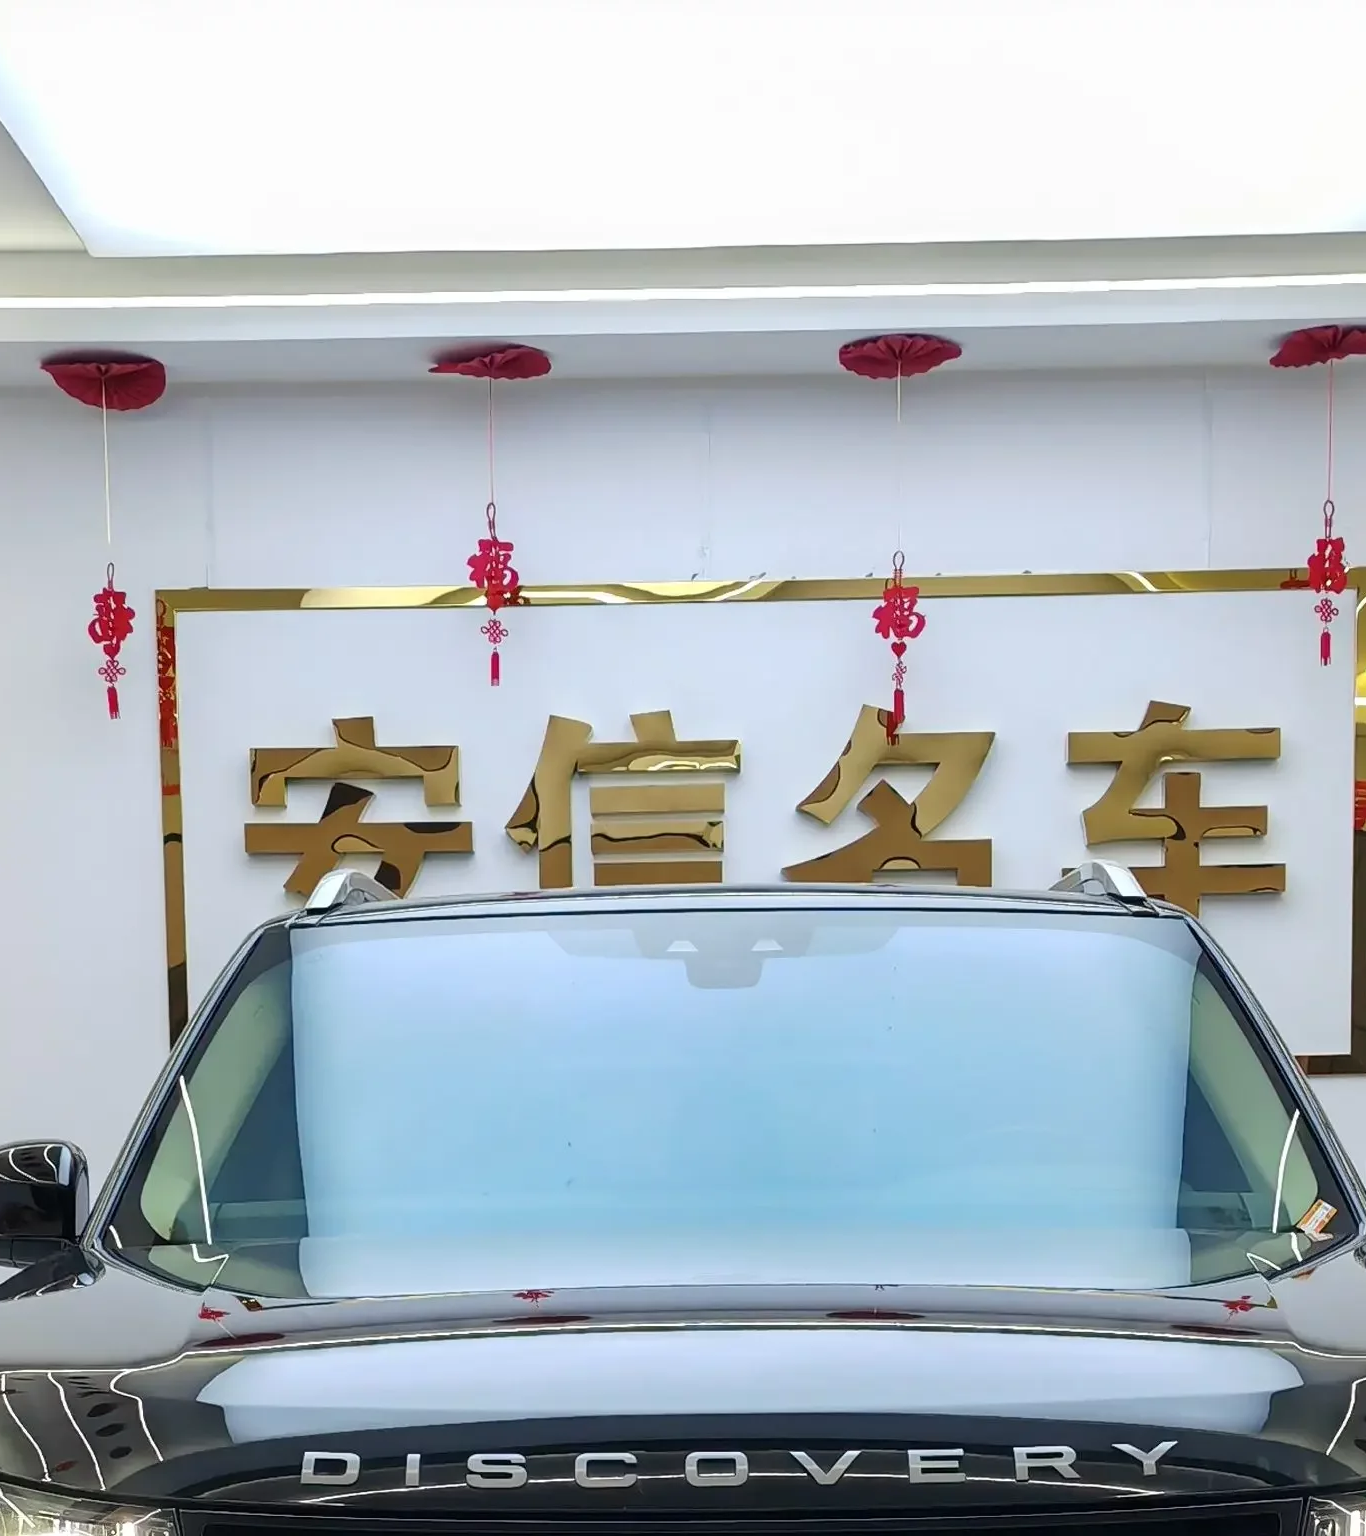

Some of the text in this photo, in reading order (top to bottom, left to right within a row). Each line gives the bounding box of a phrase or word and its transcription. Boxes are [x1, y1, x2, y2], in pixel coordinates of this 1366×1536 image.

[872, 585, 927, 640] 福
[244, 700, 1286, 913] 安信名车
[300, 1440, 1179, 1489] DISCOVERY
